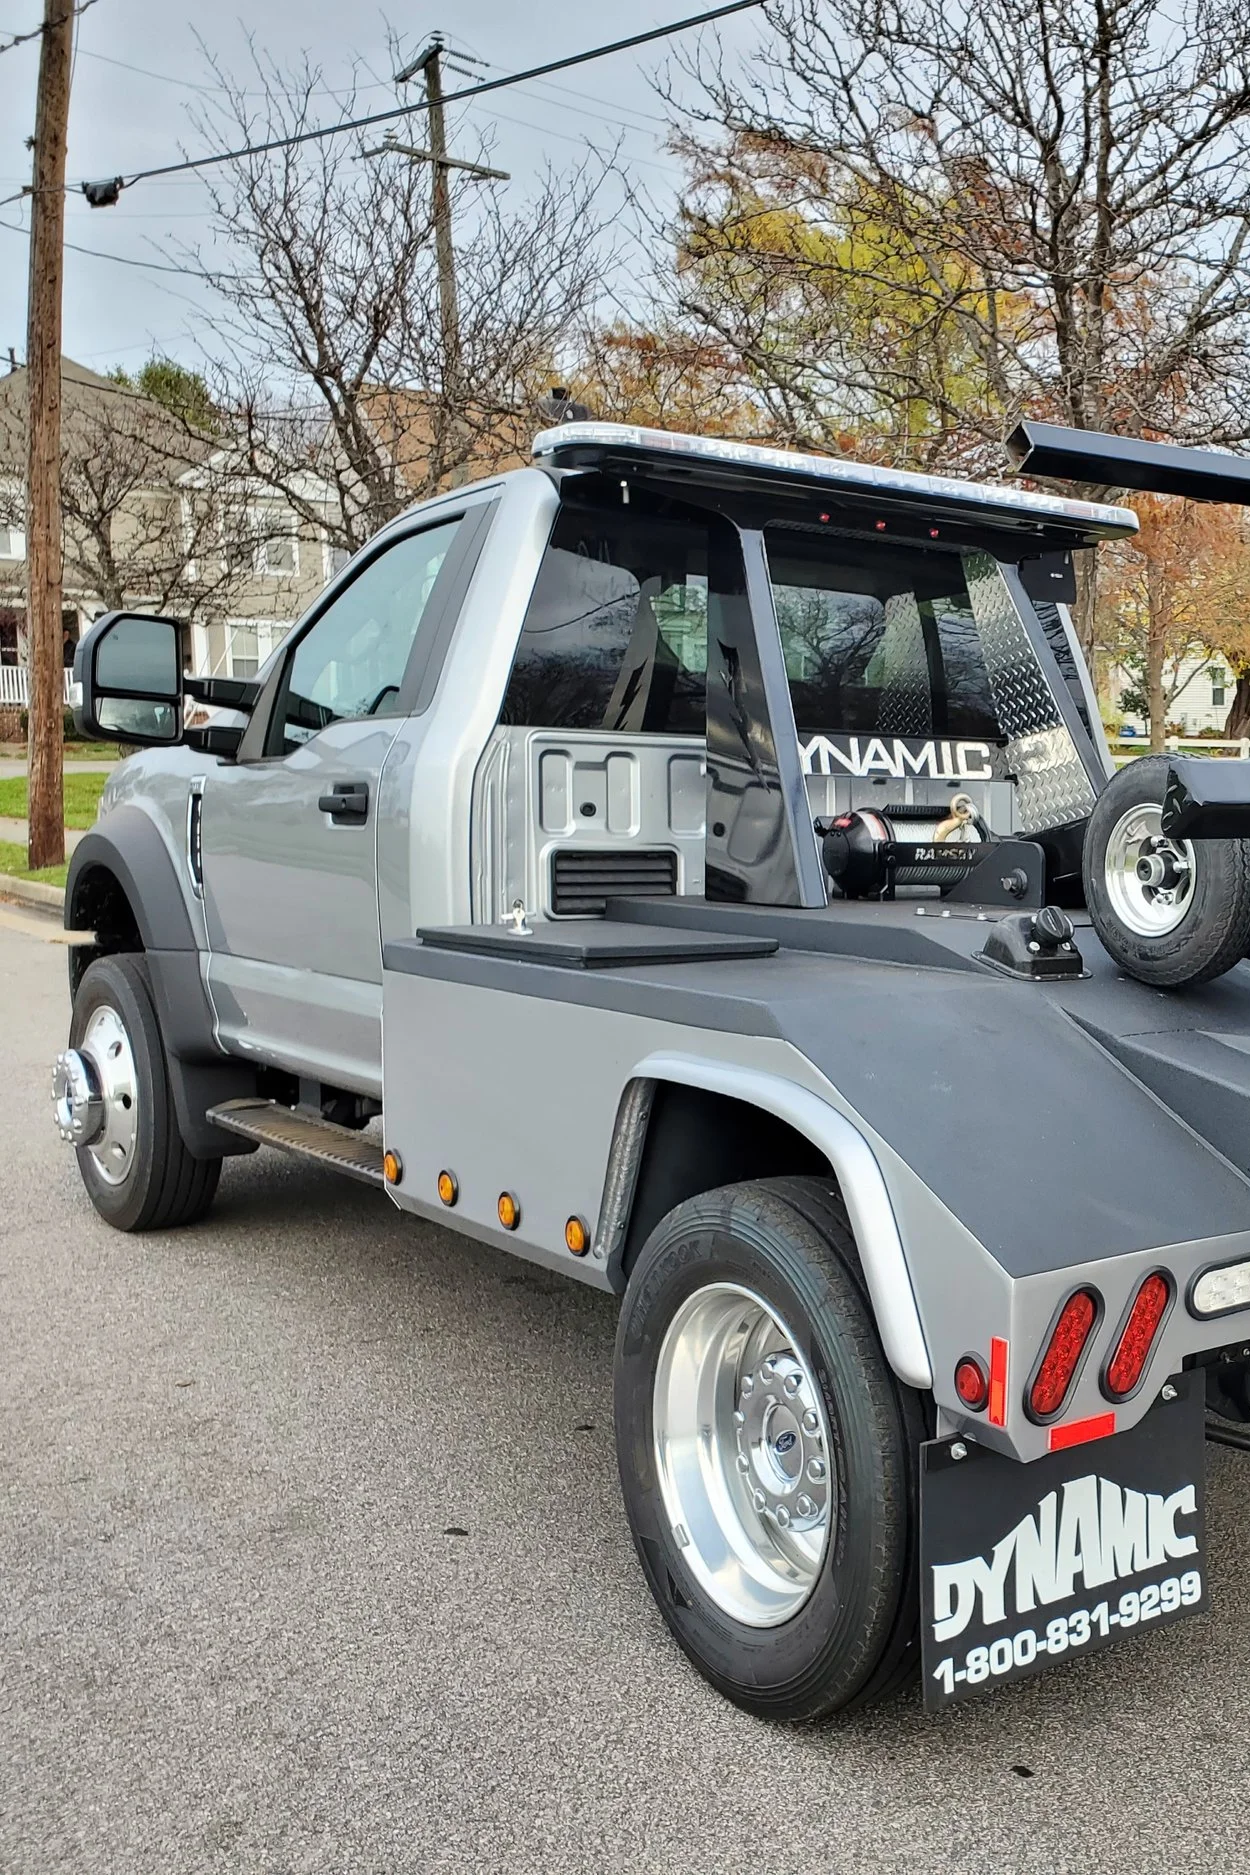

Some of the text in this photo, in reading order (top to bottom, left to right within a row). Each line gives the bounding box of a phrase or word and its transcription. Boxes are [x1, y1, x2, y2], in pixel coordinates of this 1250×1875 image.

[798, 735, 993, 780] YNAMIC
[931, 1474, 1199, 1643] DYNAMIC
[932, 1570, 1202, 1694] 1-800-831-9299
